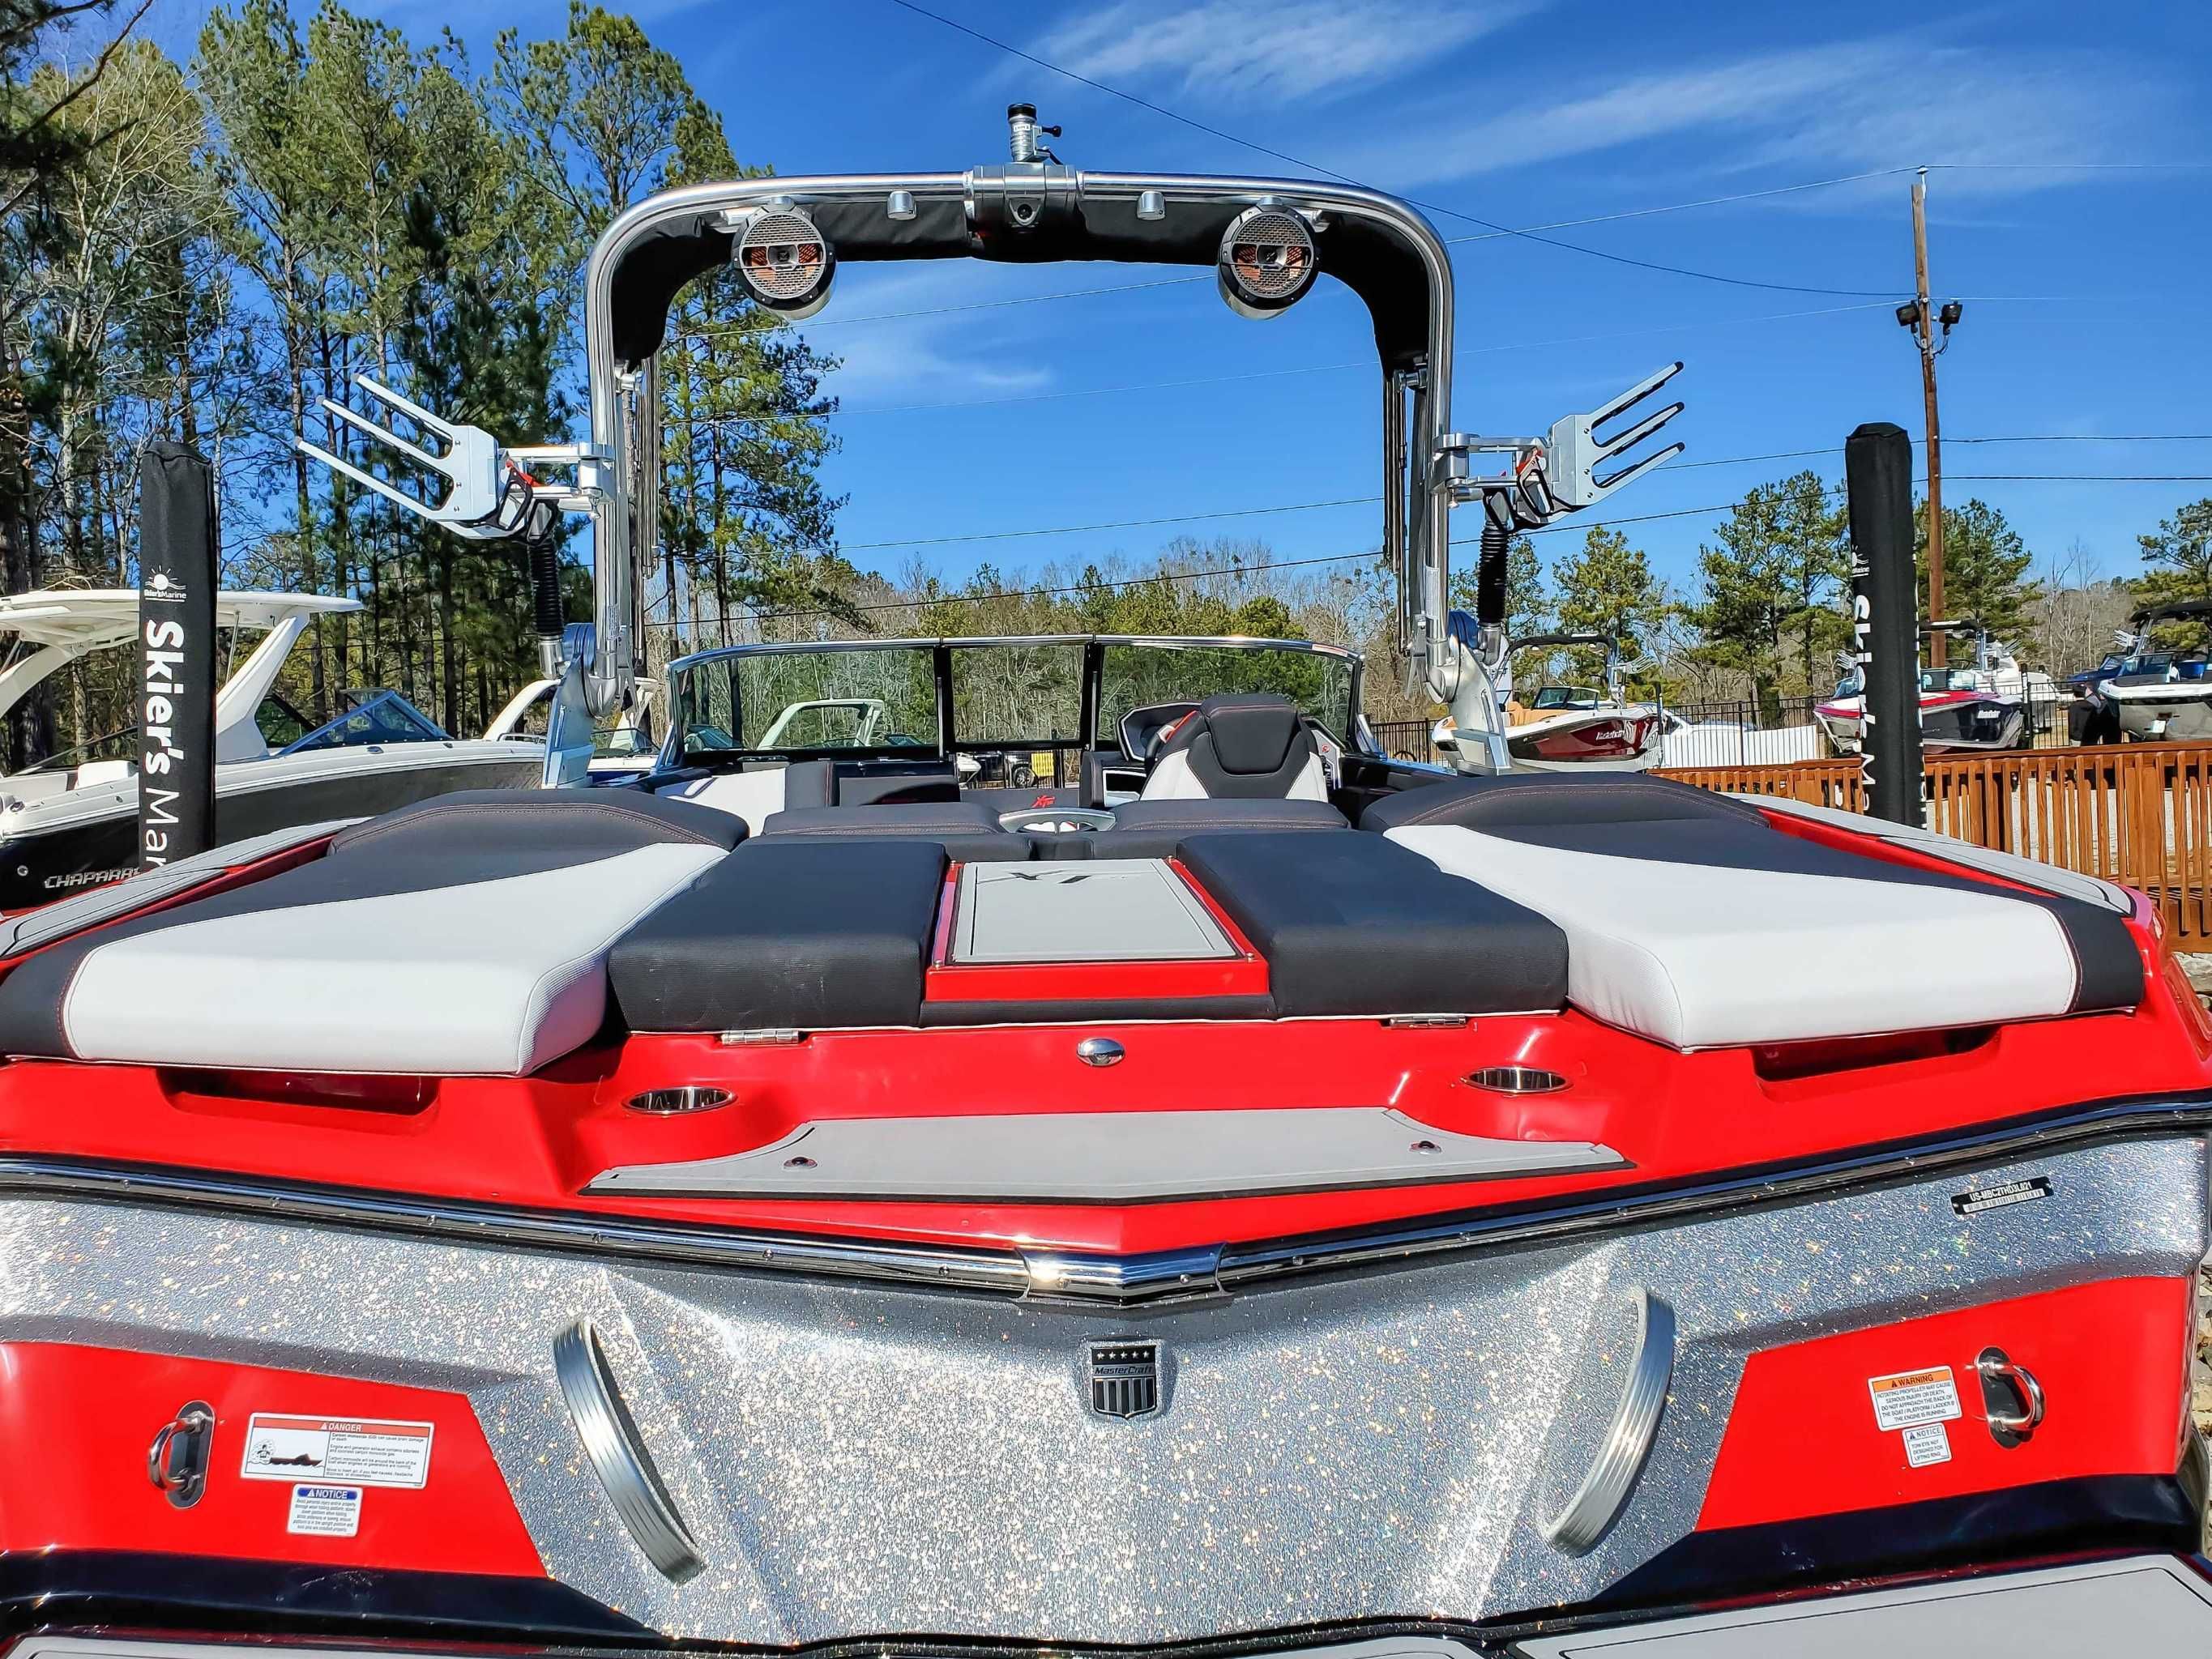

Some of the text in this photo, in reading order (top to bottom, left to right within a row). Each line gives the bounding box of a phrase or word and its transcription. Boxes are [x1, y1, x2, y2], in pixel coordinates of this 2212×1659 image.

[145, 619, 185, 775] Skier's
[1095, 1366, 1154, 1375] MasterCraft
[1898, 1374, 1933, 1386] WARNING
[1900, 1386, 1925, 1396] PROPELLER
[1899, 1399, 1923, 1408] APPROACH
[329, 1422, 361, 1431] DANGER
[1917, 1427, 1941, 1437] NOTICE
[316, 1490, 348, 1499] NOTICE
